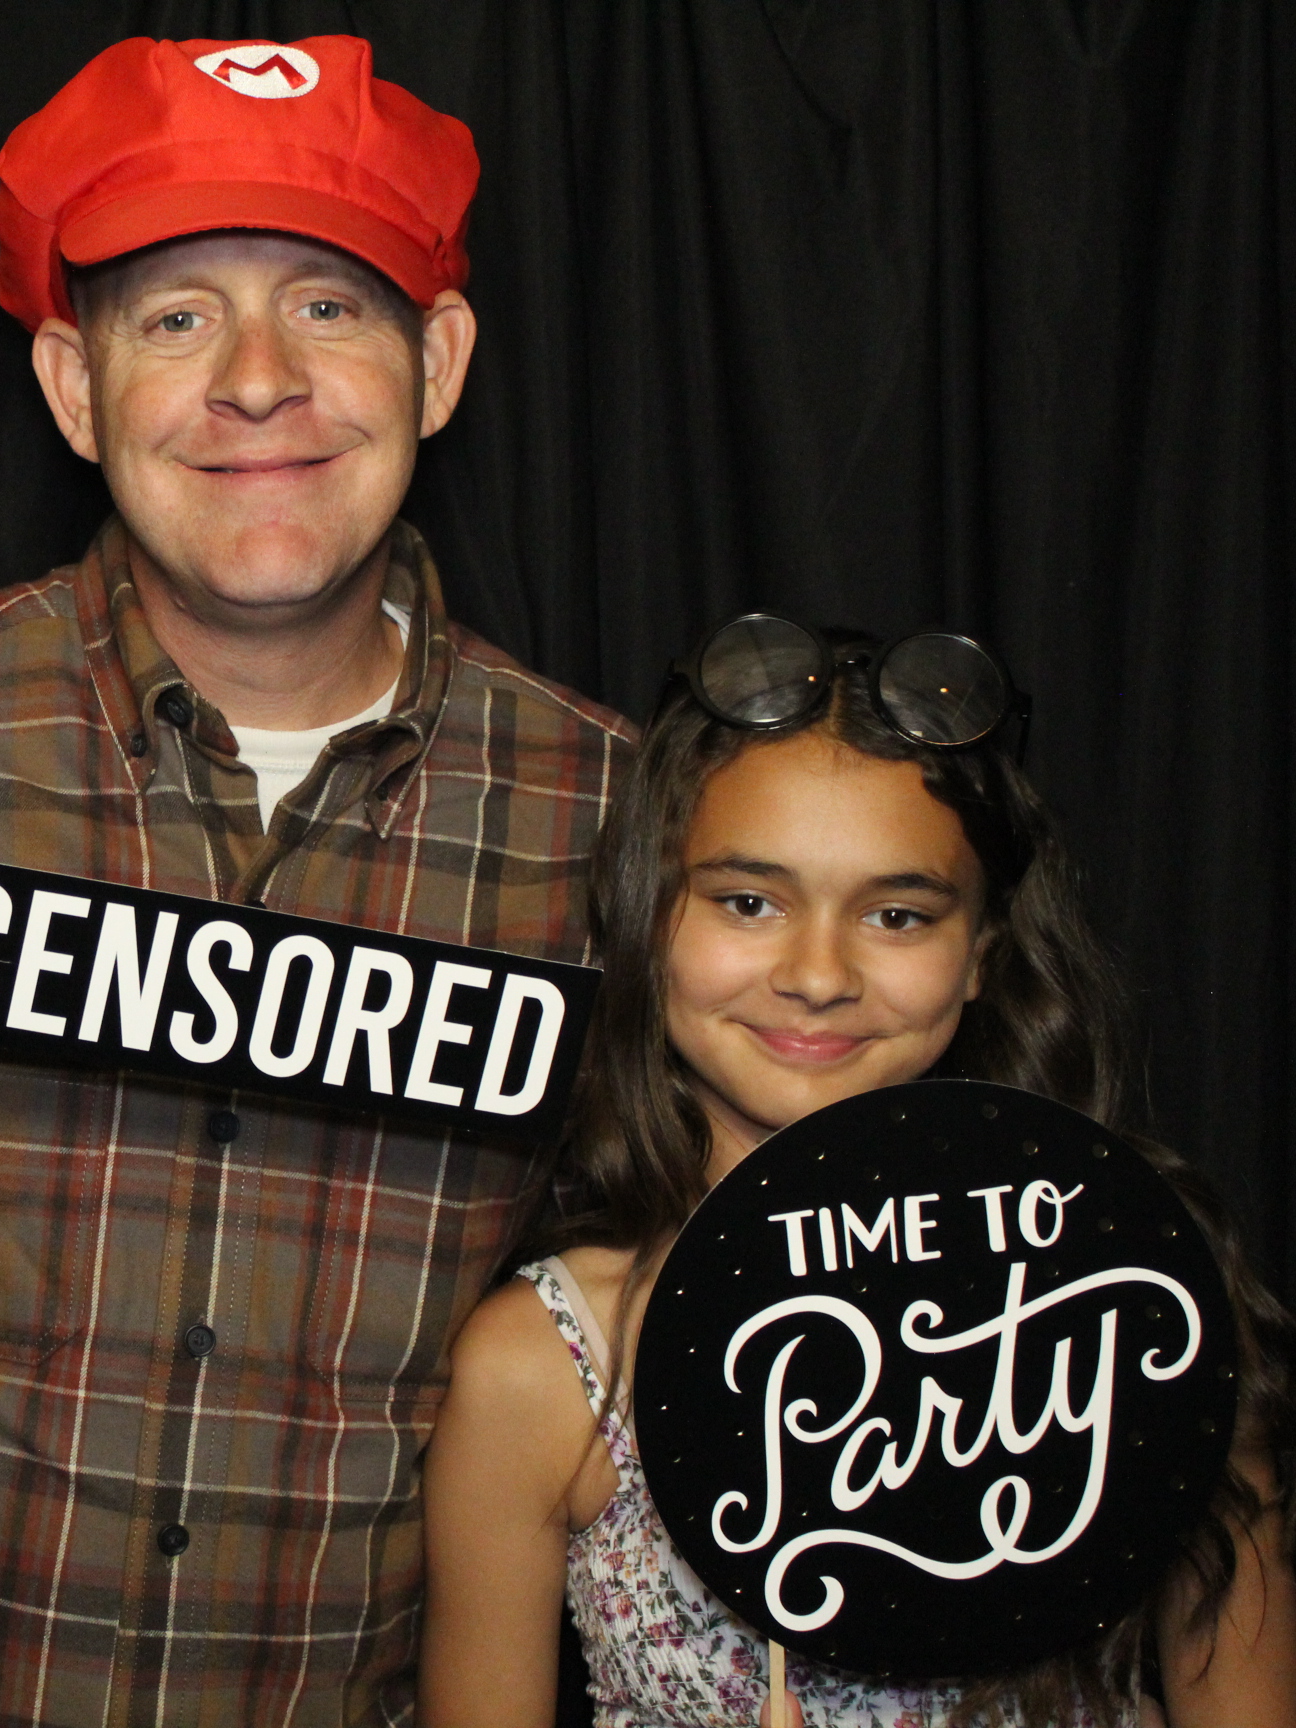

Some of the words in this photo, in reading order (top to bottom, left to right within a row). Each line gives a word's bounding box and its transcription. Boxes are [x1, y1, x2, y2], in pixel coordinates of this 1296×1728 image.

[212, 53, 308, 90] M
[767, 1193, 942, 1277] TIME
[966, 1179, 1084, 1253] TO
[711, 1262, 1202, 1633] Party
